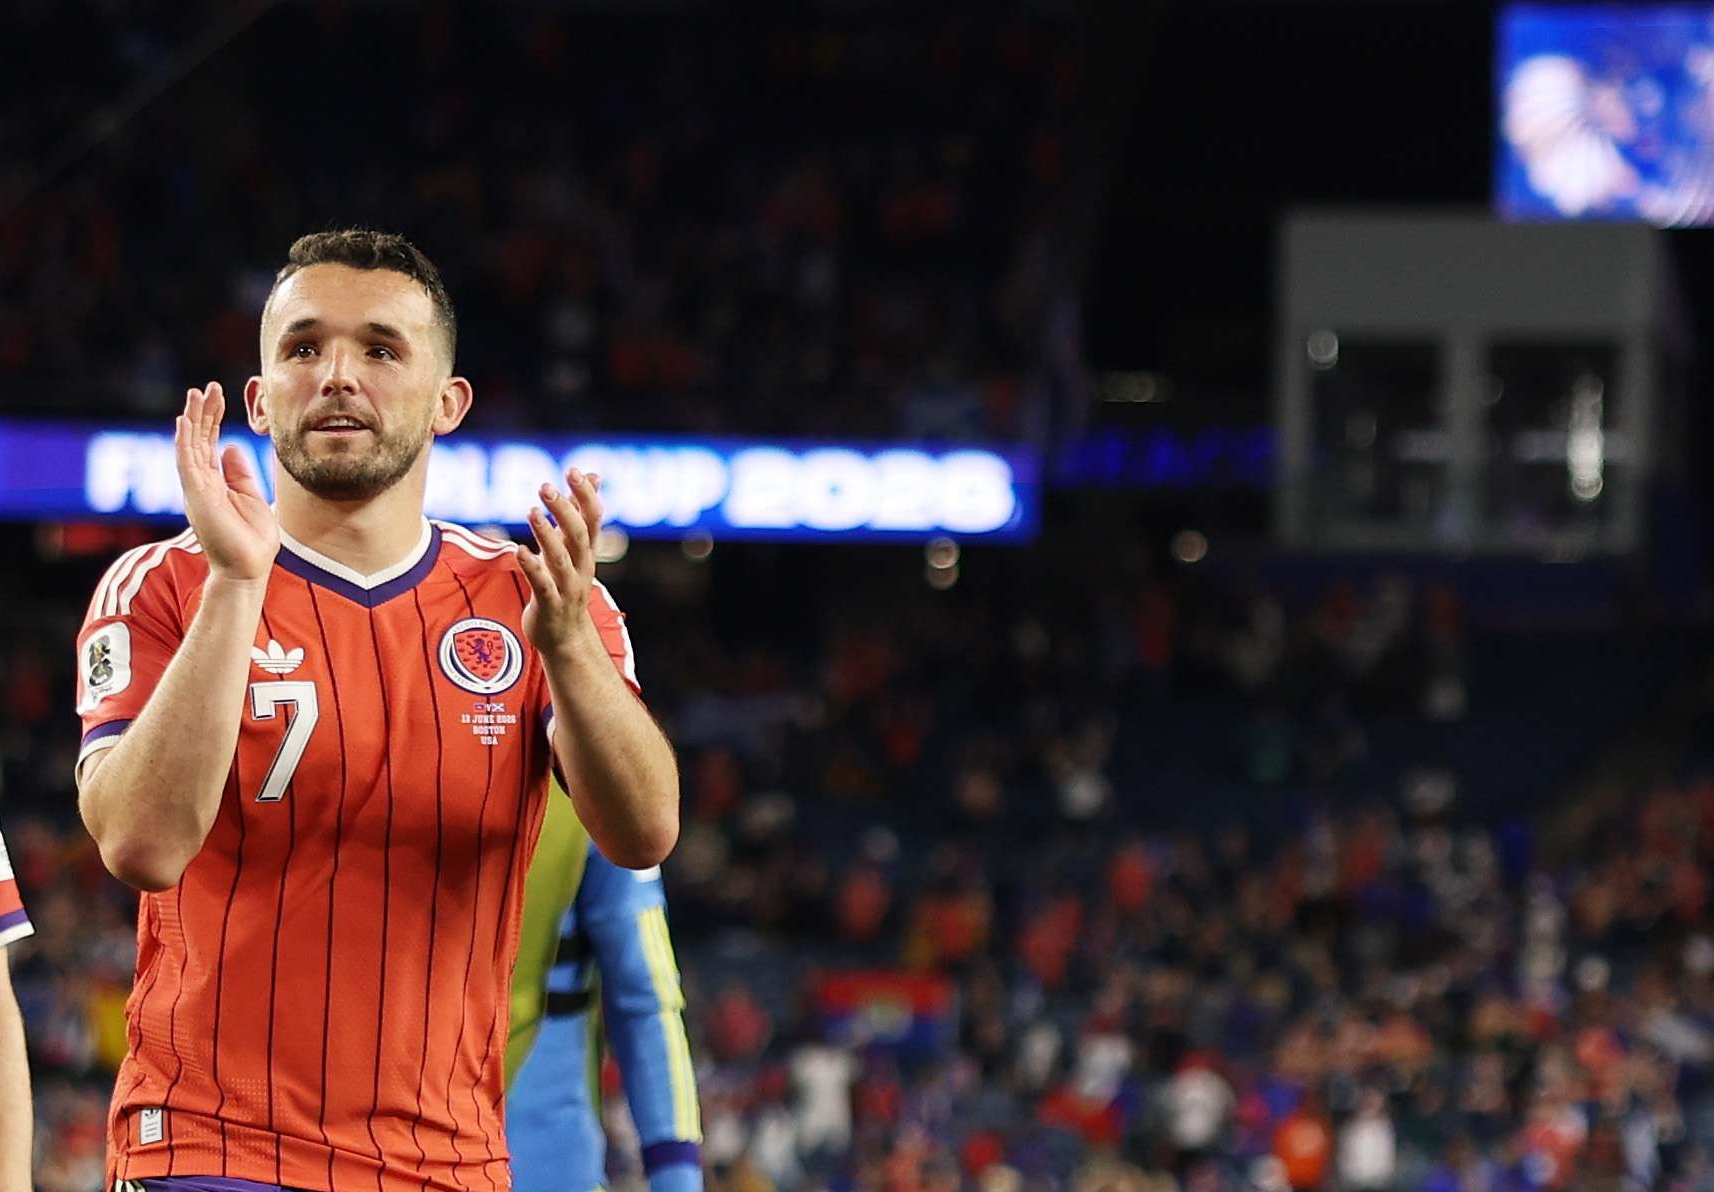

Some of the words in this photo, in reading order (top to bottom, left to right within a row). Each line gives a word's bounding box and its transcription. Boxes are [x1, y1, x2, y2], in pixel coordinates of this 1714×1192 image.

[472, 713, 495, 724] JUNE
[472, 725, 506, 735] BOSTON
[250, 680, 319, 802] 7
[480, 736, 499, 745] USA
